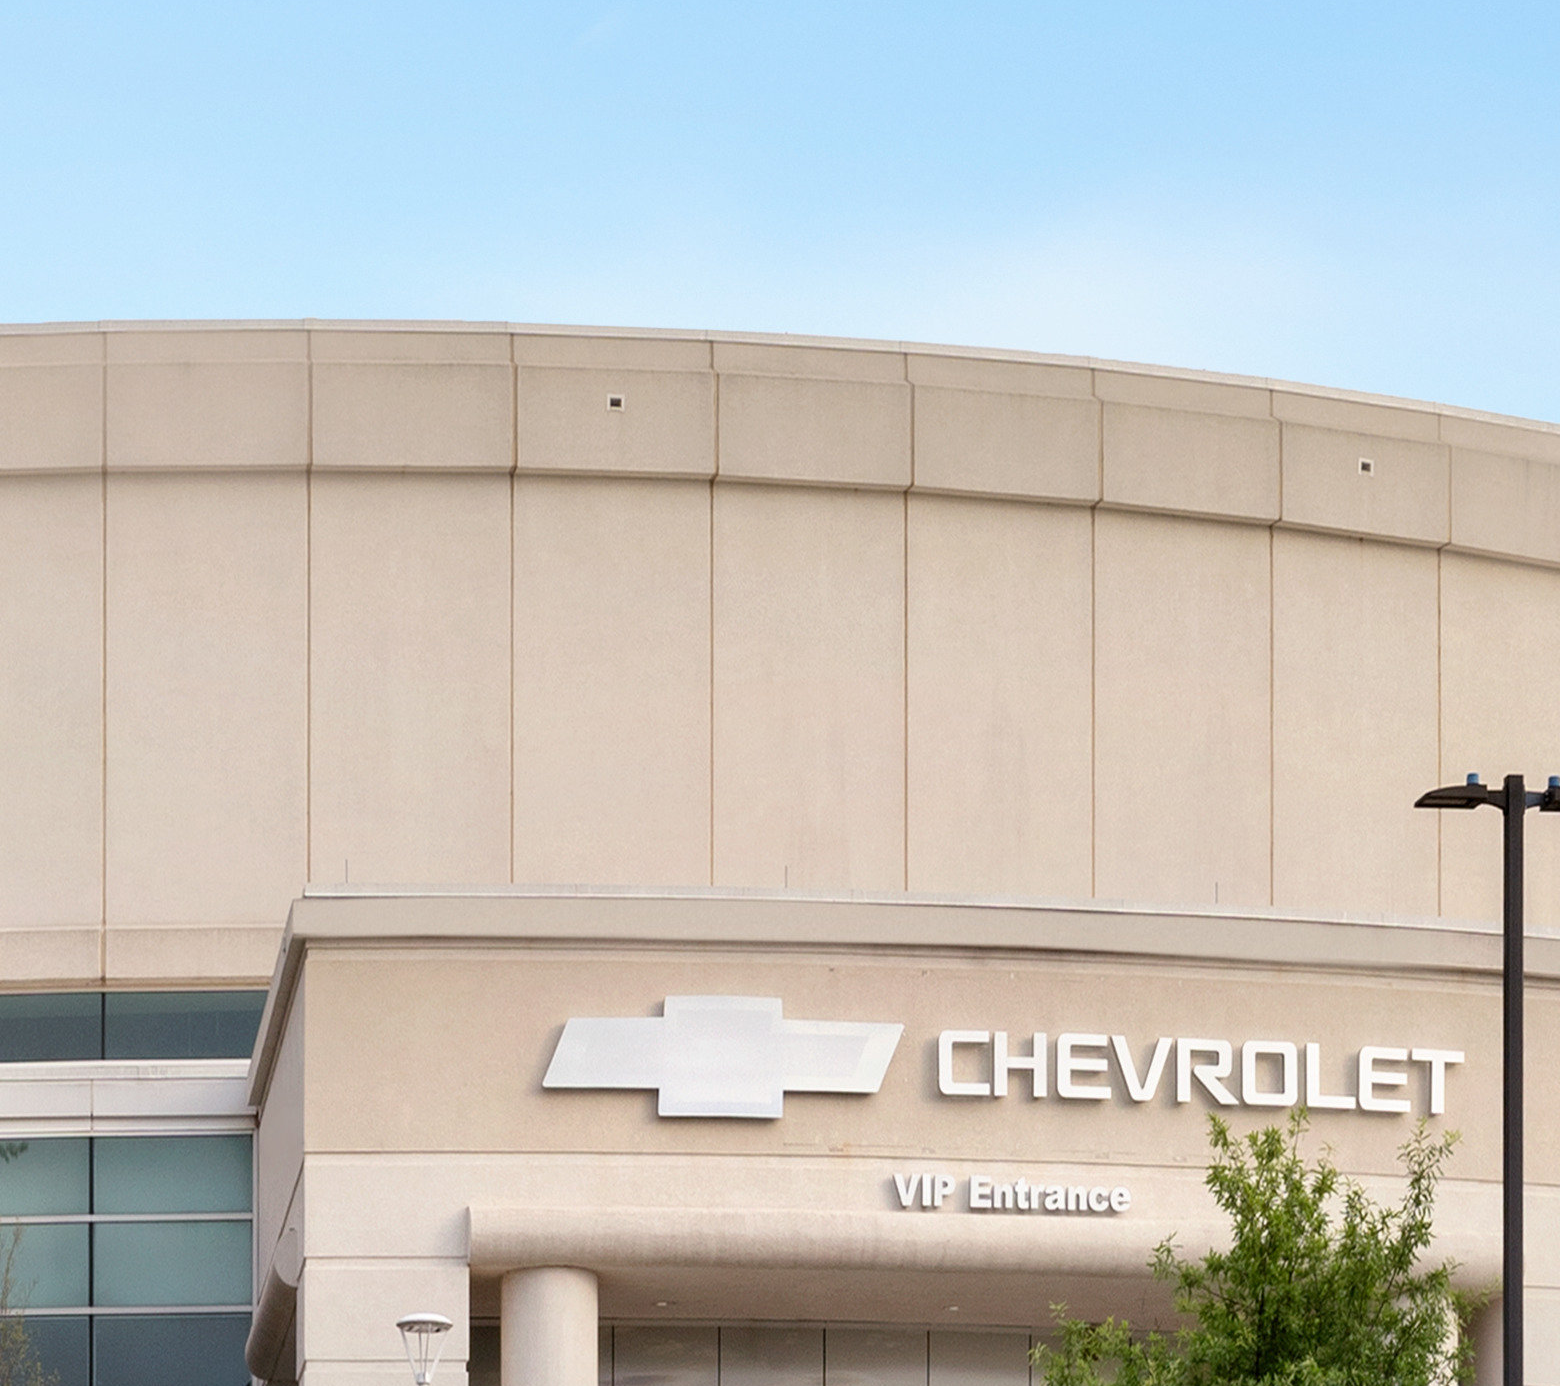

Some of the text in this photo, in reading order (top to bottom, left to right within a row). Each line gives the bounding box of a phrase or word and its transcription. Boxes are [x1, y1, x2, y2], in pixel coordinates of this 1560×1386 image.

[938, 1029, 1465, 1114] CHEVROLET
[893, 1173, 1131, 1213] VIP Entrance
